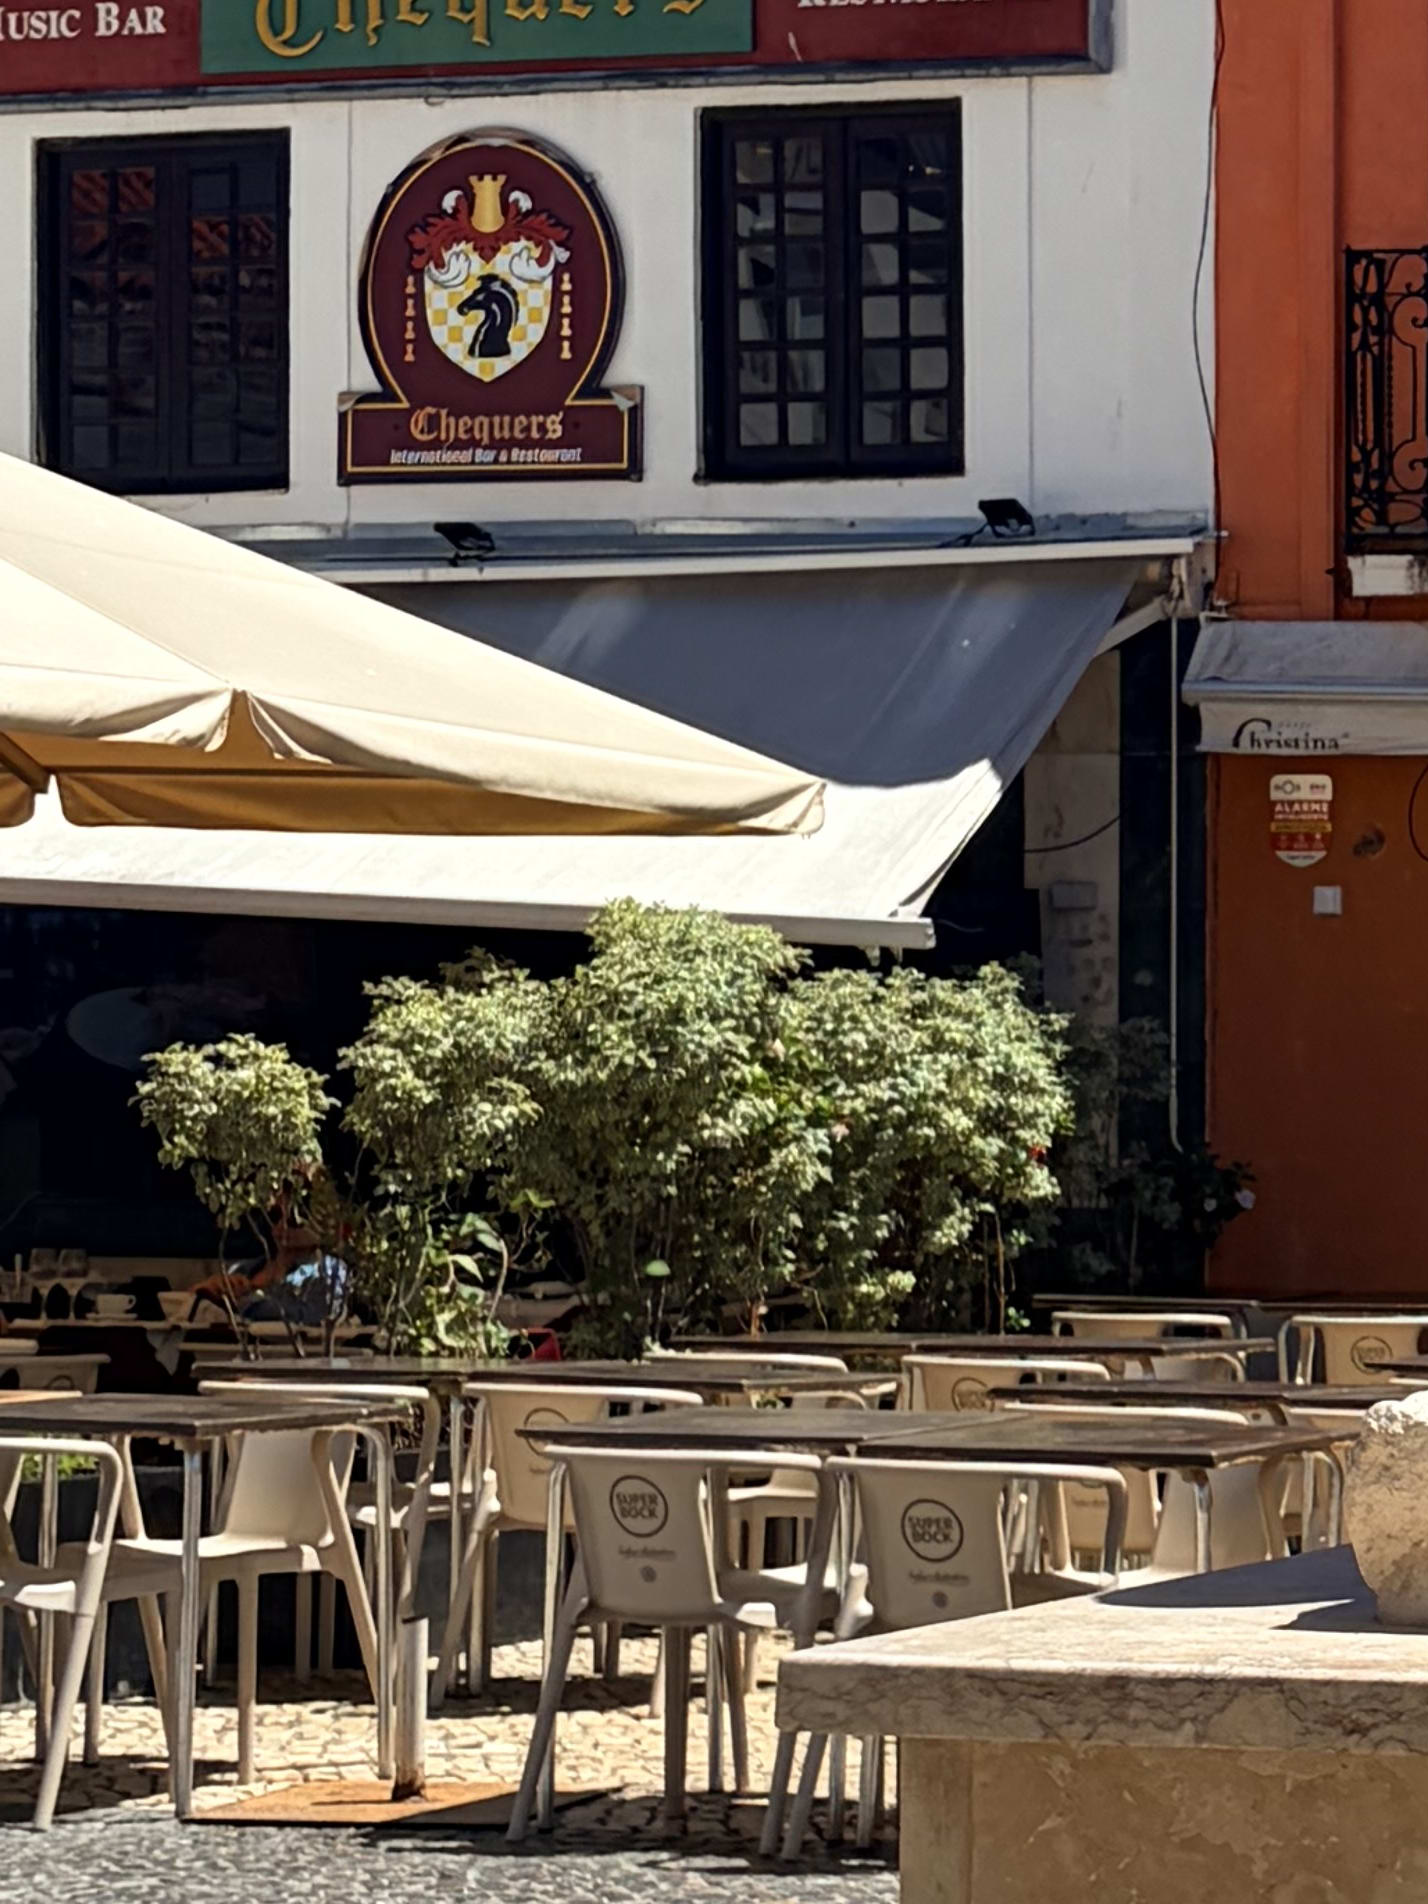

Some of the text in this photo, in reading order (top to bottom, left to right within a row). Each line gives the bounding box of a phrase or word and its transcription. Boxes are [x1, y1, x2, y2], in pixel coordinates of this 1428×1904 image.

[410, 406, 563, 447] Chequers
[390, 448, 472, 464] International
[474, 448, 497, 463] Bar
[511, 447, 582, 463] Restaurant
[1232, 718, 1340, 750] Christina
